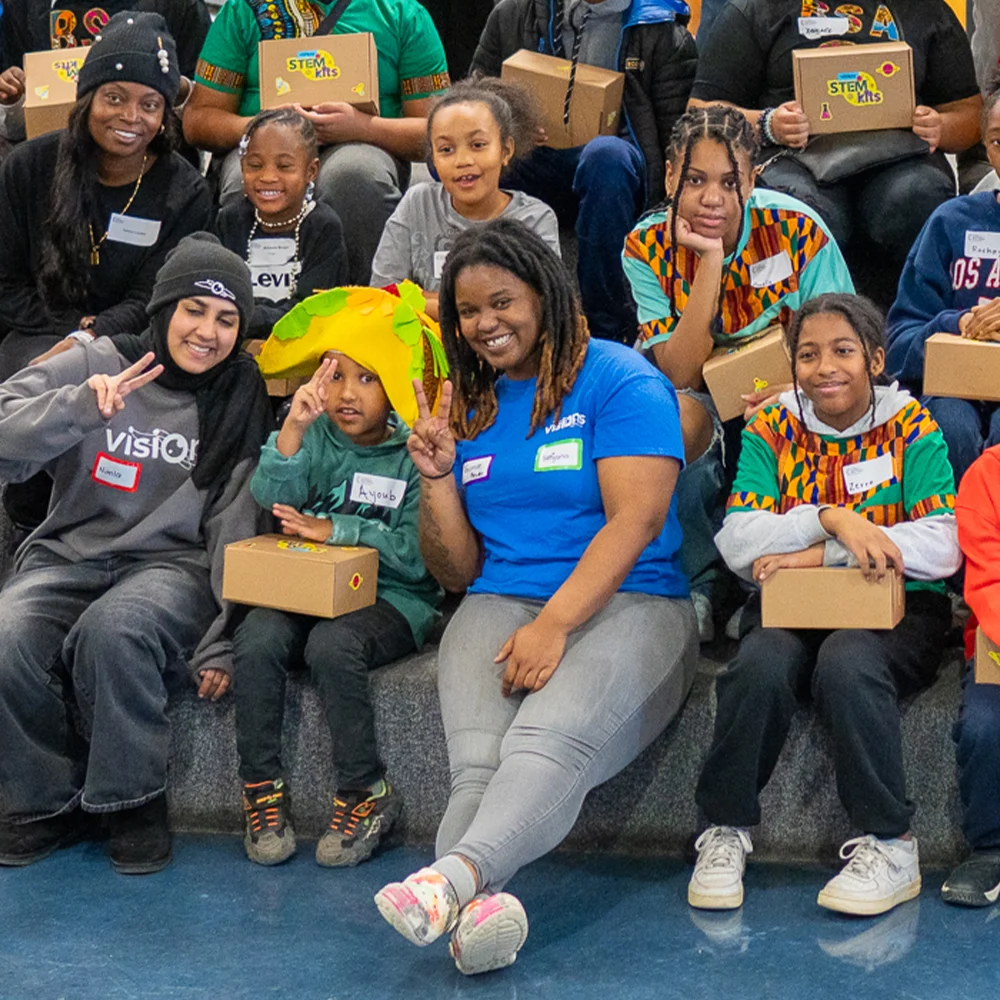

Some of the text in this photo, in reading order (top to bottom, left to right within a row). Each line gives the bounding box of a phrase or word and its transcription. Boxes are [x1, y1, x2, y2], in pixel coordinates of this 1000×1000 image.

[289, 57, 325, 70] STEM
[315, 66, 339, 79] kits
[830, 80, 868, 94] STEM
[857, 89, 882, 104] kits
[950, 257, 982, 291] OS
[358, 484, 397, 505] Ayoub
